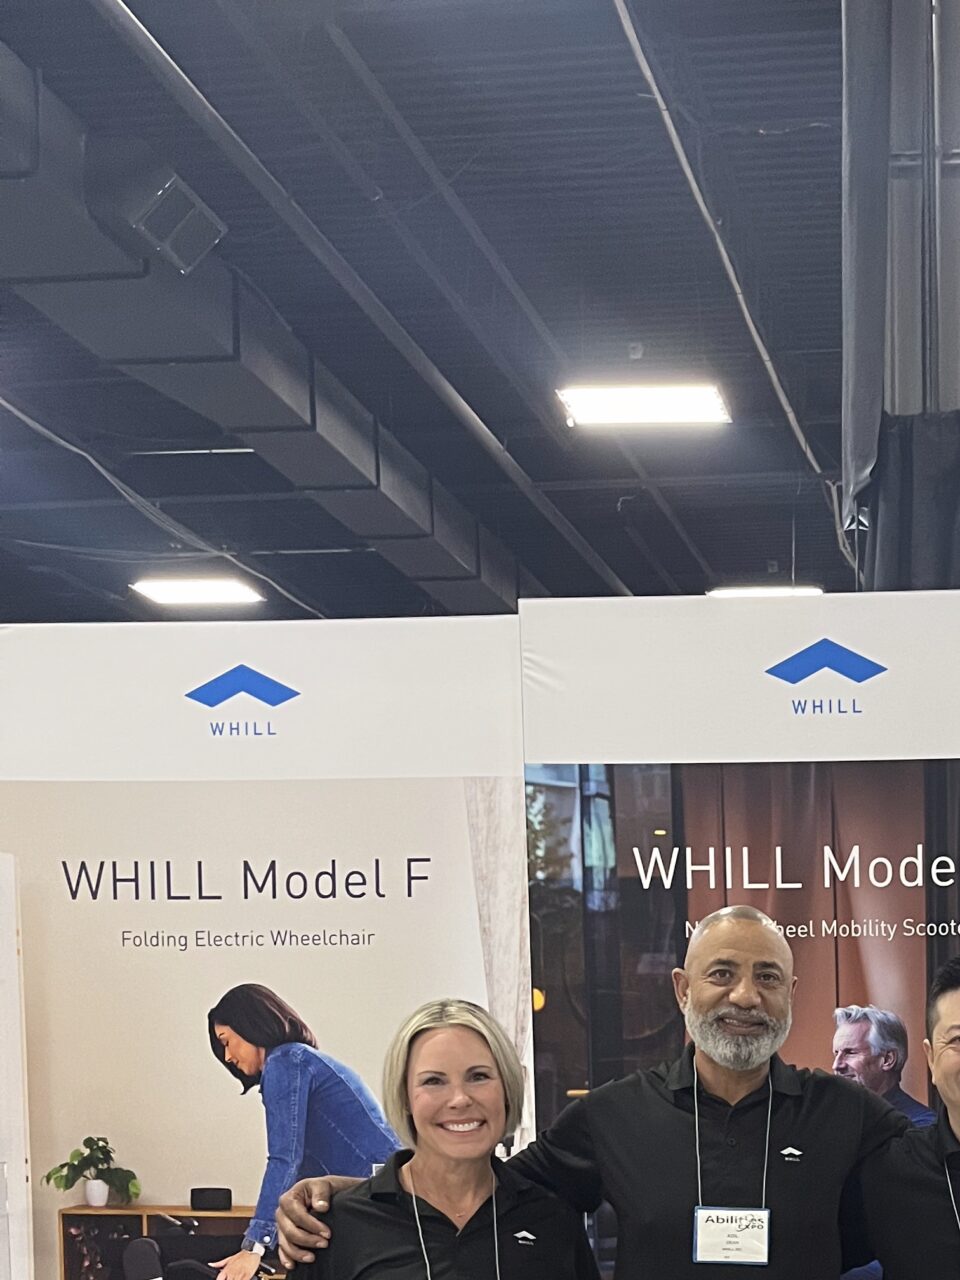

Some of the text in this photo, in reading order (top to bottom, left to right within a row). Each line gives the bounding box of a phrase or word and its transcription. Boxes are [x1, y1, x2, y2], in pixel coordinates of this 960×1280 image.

[791, 698, 863, 715] WHILL
[209, 721, 277, 736] WHILL
[61, 857, 432, 901] WHILL Model F
[632, 846, 803, 890] WHILL
[121, 929, 376, 952] Folding Electric Wheelchair
[821, 918, 898, 942] Mobility
[704, 1215, 765, 1224] Abilities
